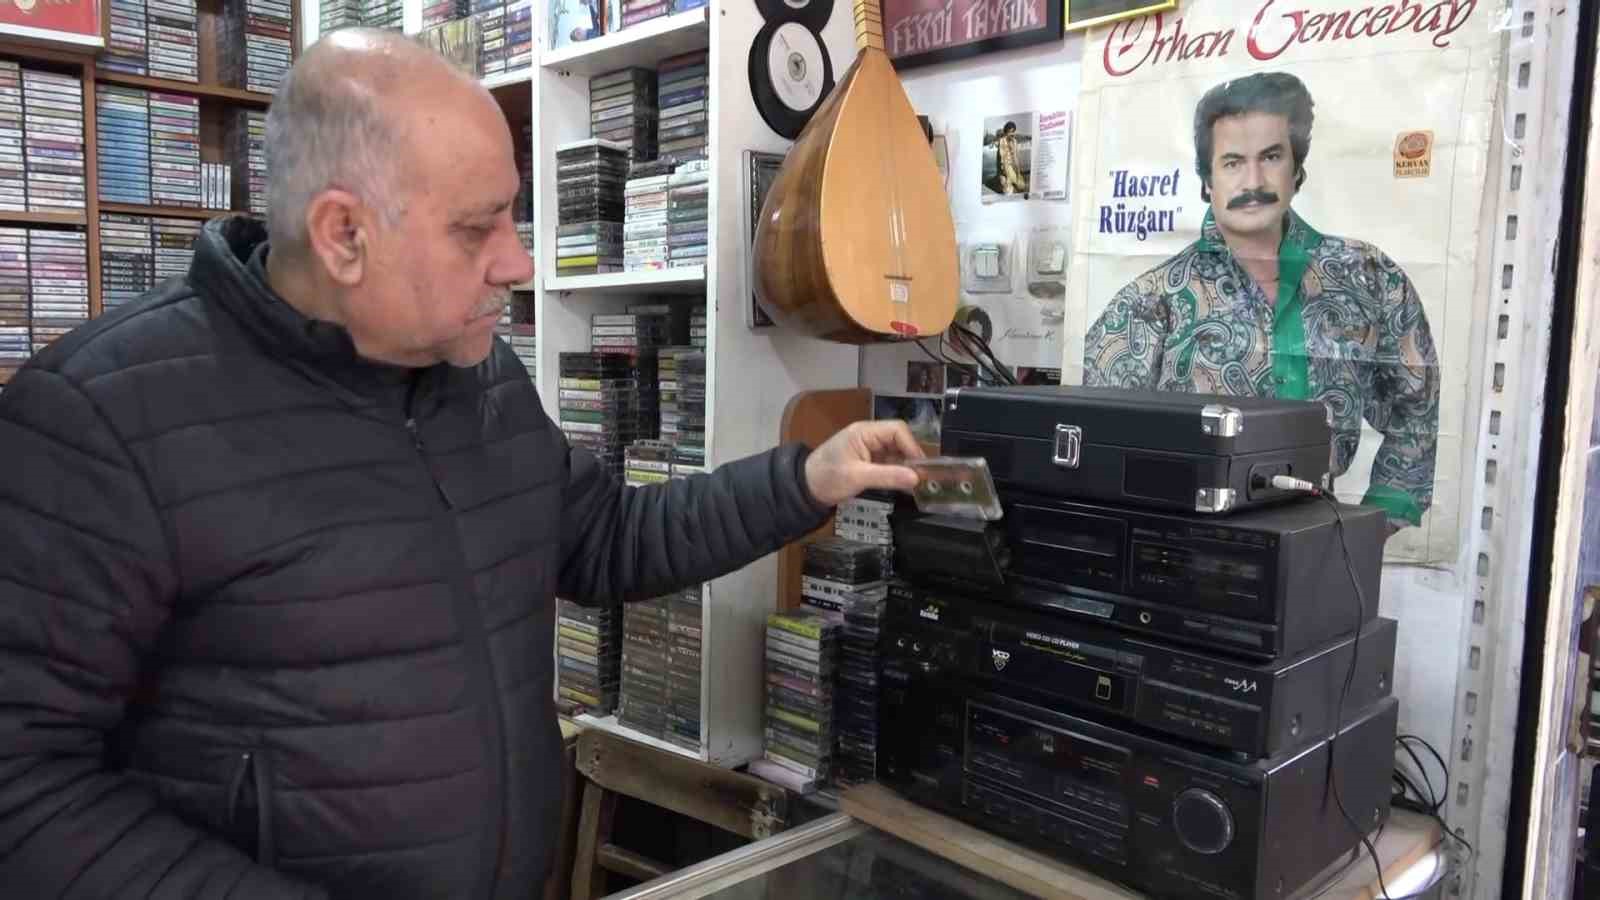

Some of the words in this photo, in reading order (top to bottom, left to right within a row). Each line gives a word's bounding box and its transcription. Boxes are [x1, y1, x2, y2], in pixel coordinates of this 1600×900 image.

[1103, 12, 1235, 76] Orhan
[1246, 0, 1477, 61] Gencebay
[1109, 168, 1181, 198] "Hasret
[1099, 203, 1183, 241] Rüzgarı"
